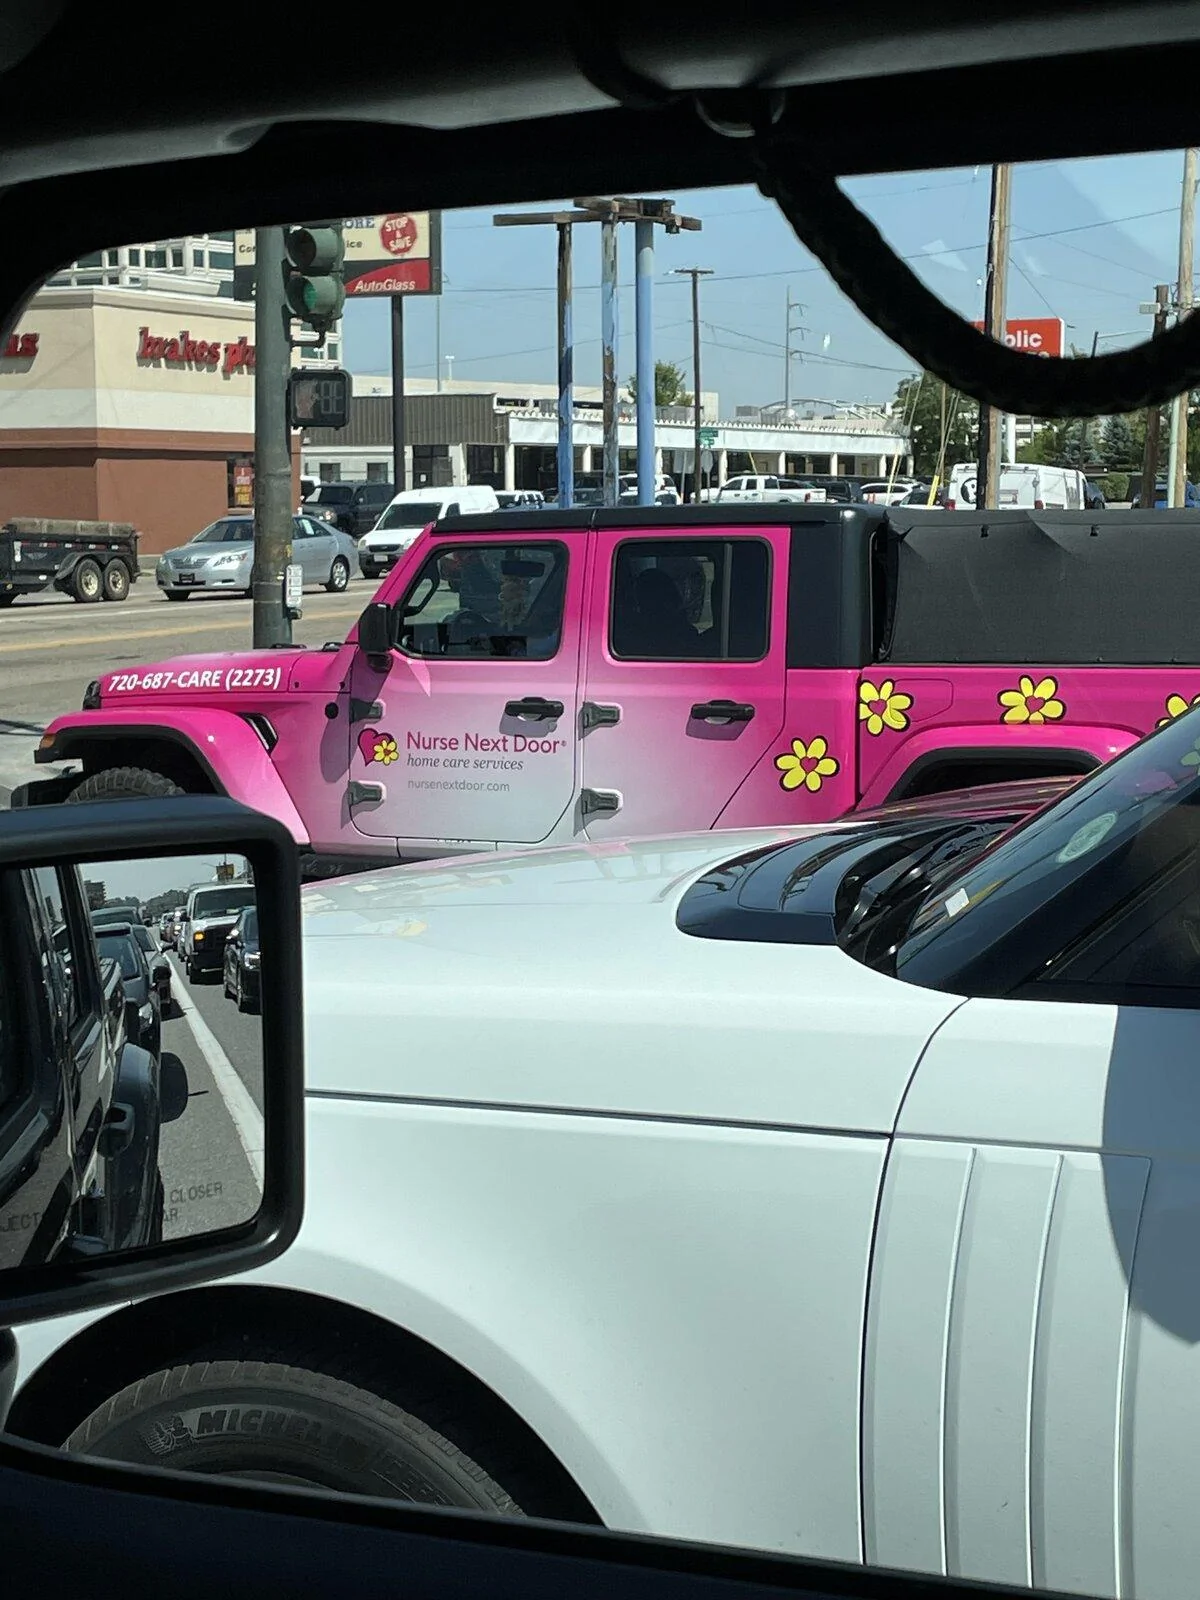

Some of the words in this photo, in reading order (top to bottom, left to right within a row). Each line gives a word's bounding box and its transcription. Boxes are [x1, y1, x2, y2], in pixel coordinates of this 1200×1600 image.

[343, 216, 375, 229] ORE
[385, 216, 408, 233] STOP
[346, 240, 363, 249] ice
[389, 235, 412, 252] SAVE
[353, 278, 416, 293] AutoGlass
[1004, 330, 1042, 348] blic
[138, 326, 221, 362] brakes
[223, 336, 257, 374] plu
[108, 670, 223, 692] 720-687-CARE
[225, 667, 281, 691] (2273)
[406, 731, 459, 751] Nurse
[464, 733, 509, 752] Next
[406, 753, 440, 768] home
[442, 757, 470, 769] care
[473, 757, 524, 771] services
[407, 779, 510, 792] nursenextdoor.com
[170, 1181, 223, 1203] CLOSER
